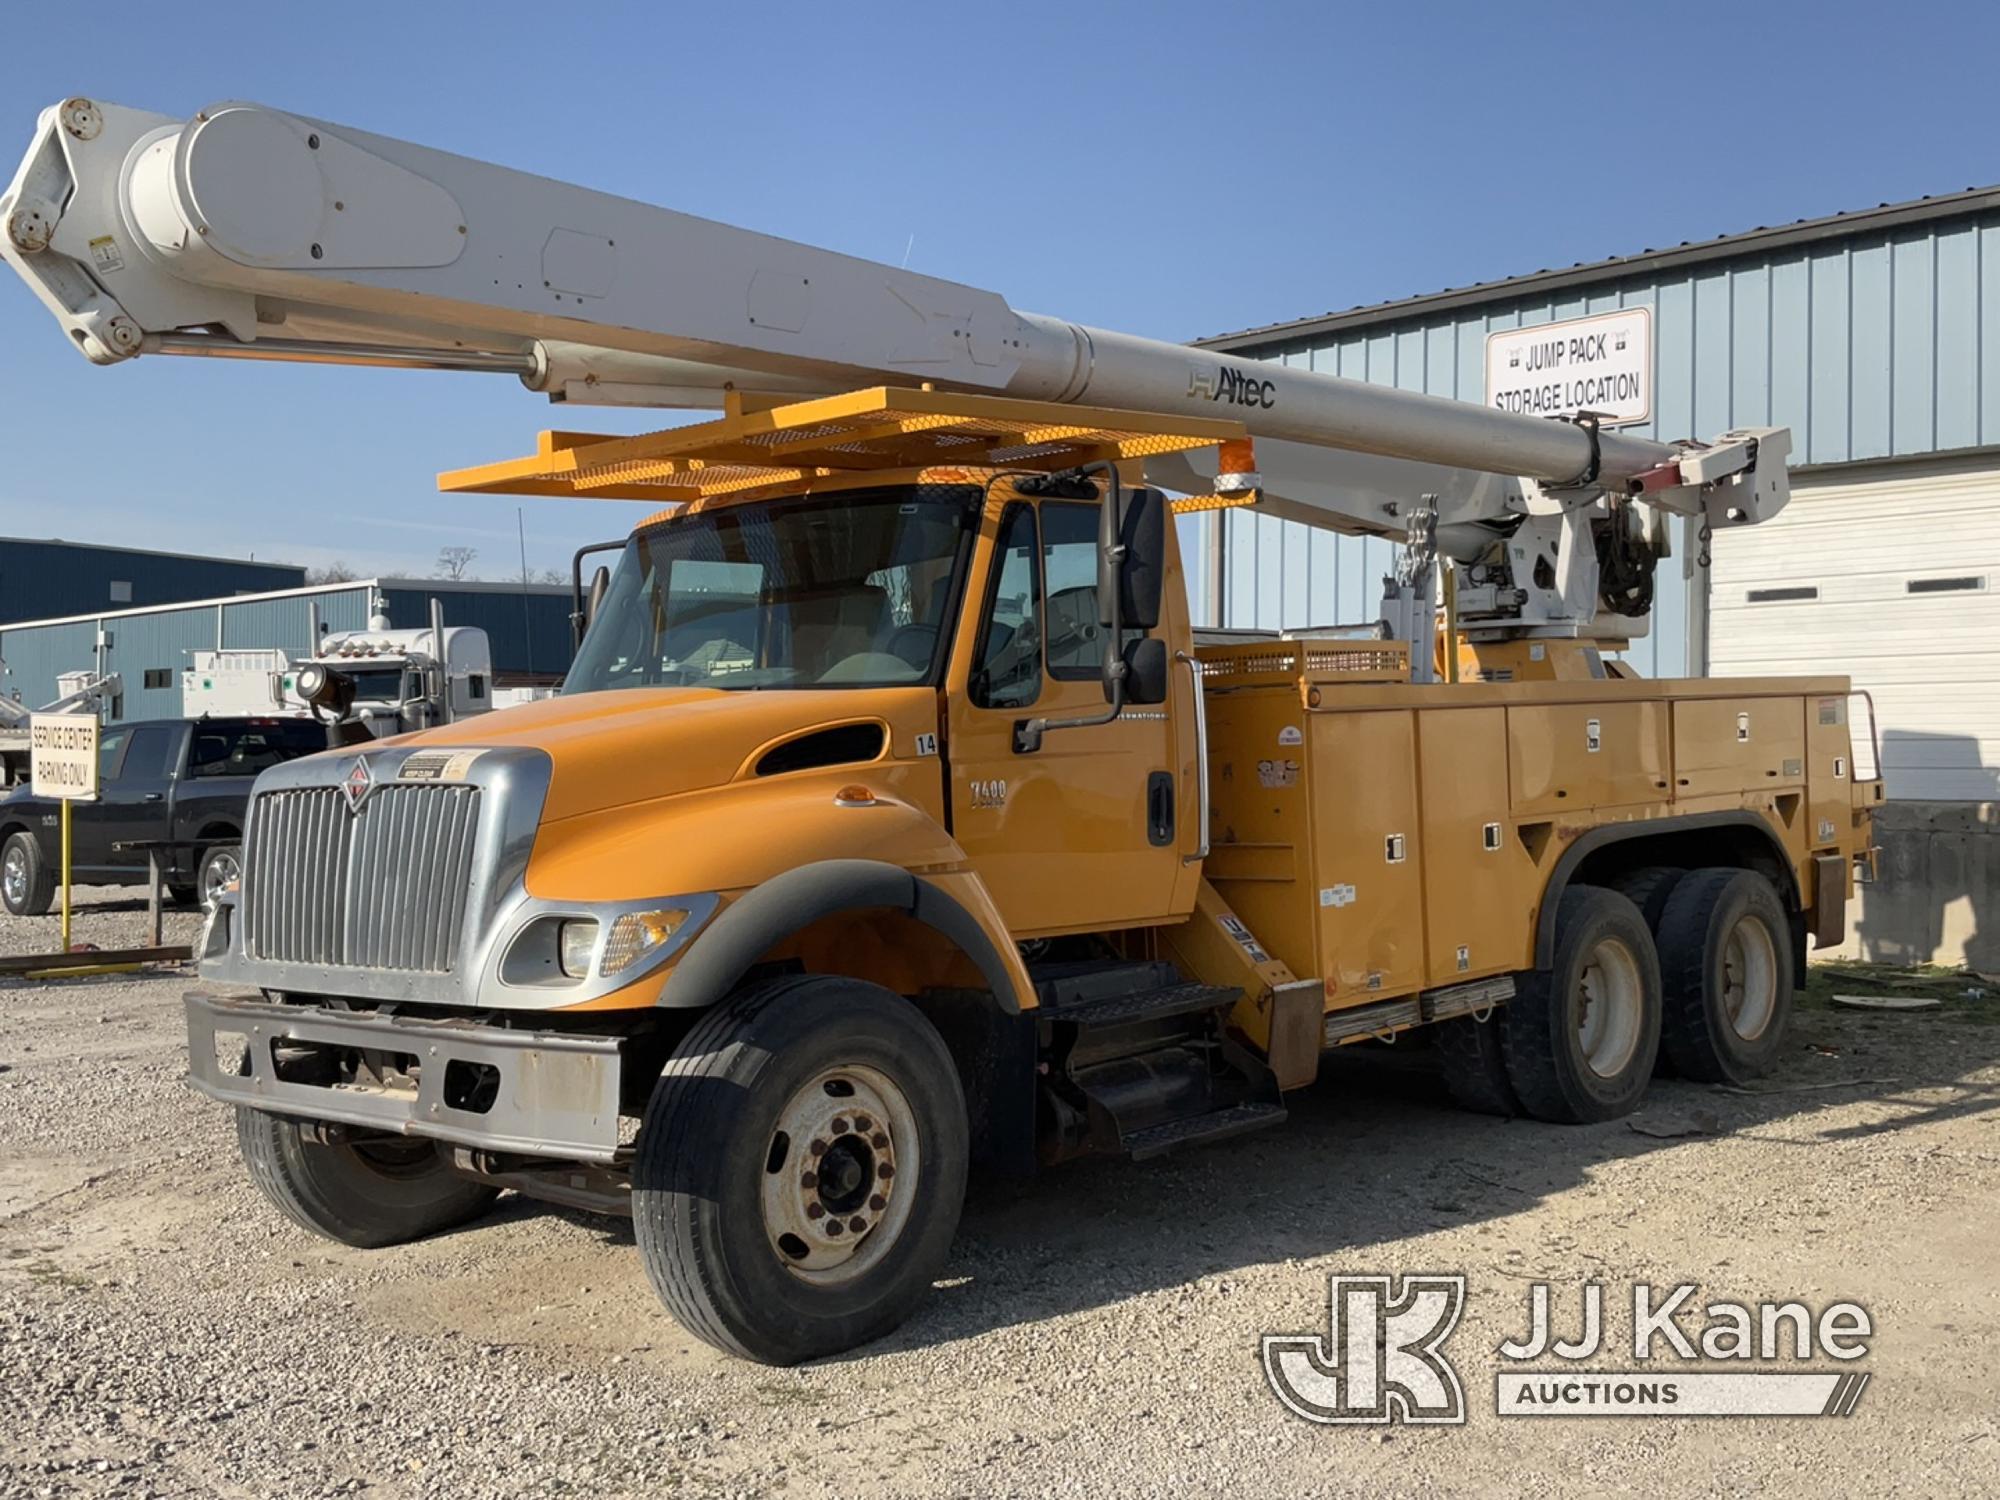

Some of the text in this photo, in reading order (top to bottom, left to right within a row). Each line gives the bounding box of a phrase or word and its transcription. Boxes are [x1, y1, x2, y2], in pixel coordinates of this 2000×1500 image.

[1525, 332, 1607, 372] JUMP PACK
[1213, 366, 1276, 409] Altec
[1495, 372, 1640, 416] STORAGE LOCATION
[34, 726, 93, 751] SERVICE CENTER
[918, 734, 936, 754] 14
[38, 761, 88, 787] PARKING ONLY
[970, 780, 1007, 800] 7400
